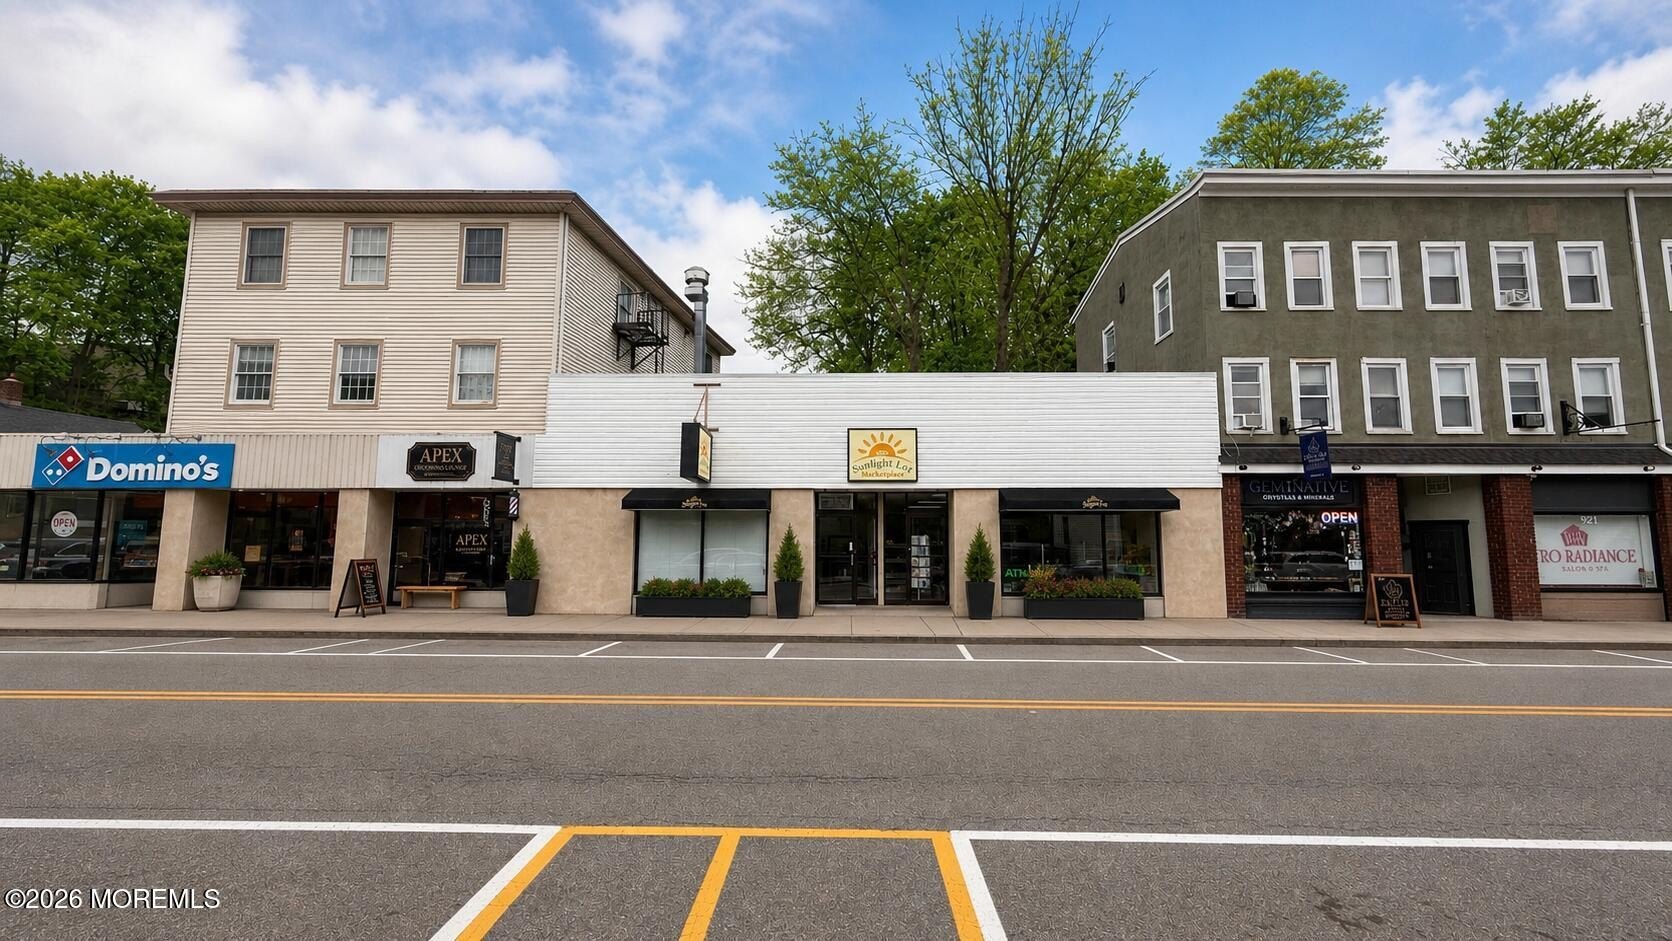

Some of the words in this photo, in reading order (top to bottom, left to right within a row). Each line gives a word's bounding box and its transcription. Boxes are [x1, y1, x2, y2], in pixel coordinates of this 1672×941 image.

[419, 448, 462, 463] APEX
[86, 455, 219, 481] Domino's
[852, 459, 893, 474] Sunlight
[1249, 480, 1350, 493] GEMINATIVE
[53, 518, 76, 528] OPEN
[1321, 511, 1358, 523] OPEN
[1580, 515, 1598, 525] 921
[455, 533, 488, 546] APEX
[1565, 549, 1637, 563] RADIANCE
